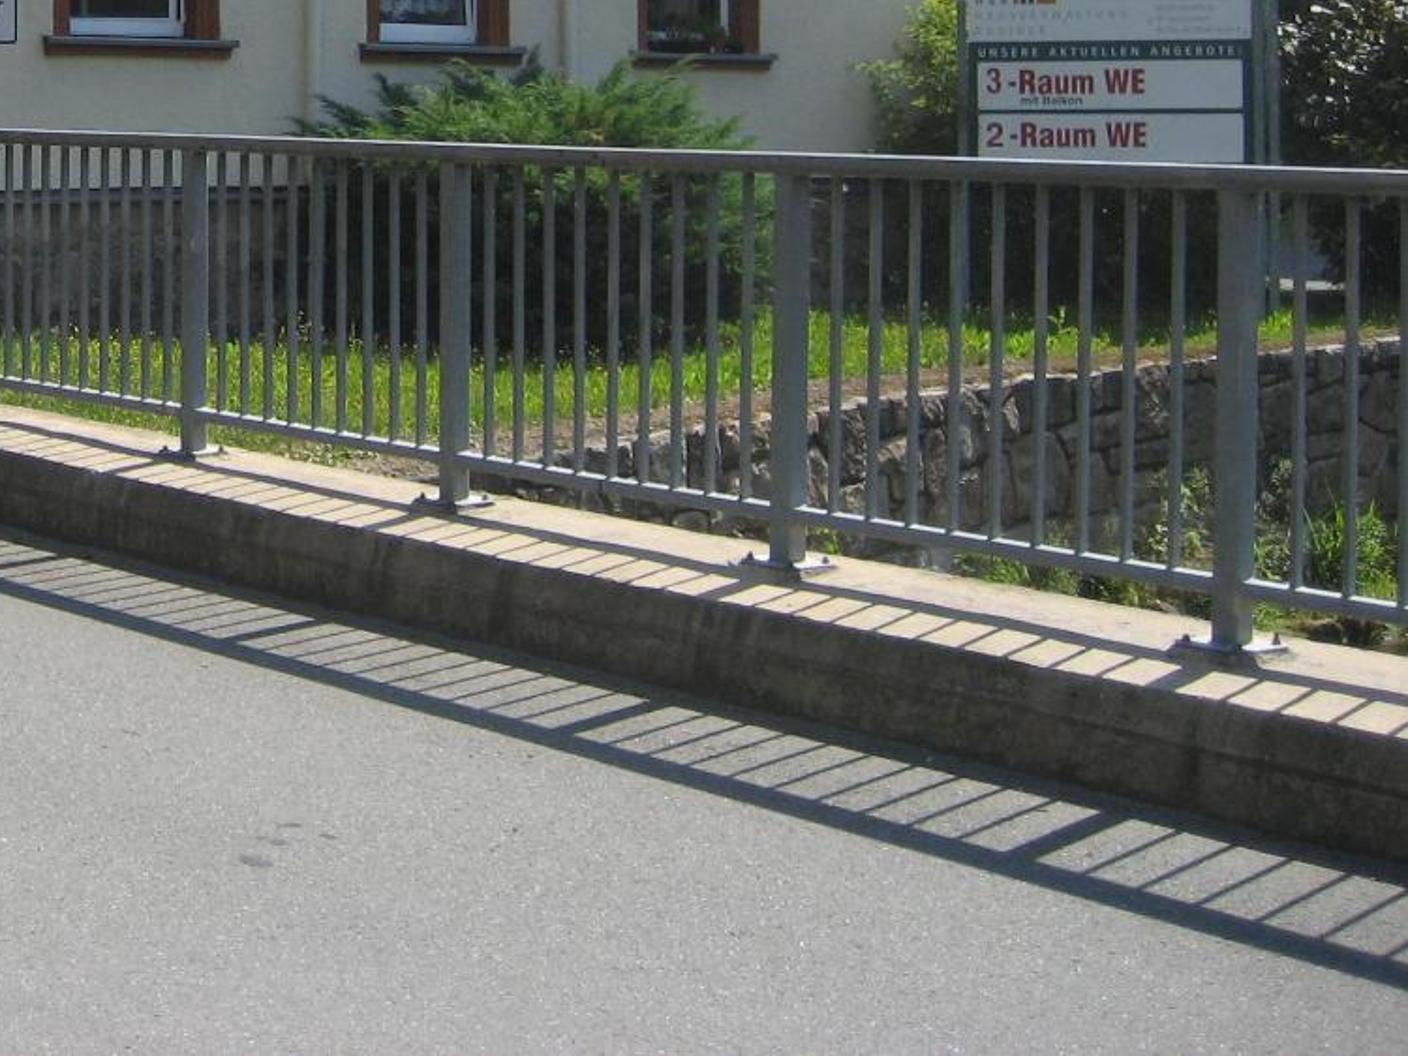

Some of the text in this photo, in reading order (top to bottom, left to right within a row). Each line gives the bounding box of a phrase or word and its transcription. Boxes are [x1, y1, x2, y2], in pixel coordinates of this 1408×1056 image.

[1048, 45, 1140, 58] AKTUELLEN
[1104, 68, 1146, 94] WE
[1106, 122, 1148, 148] WE
